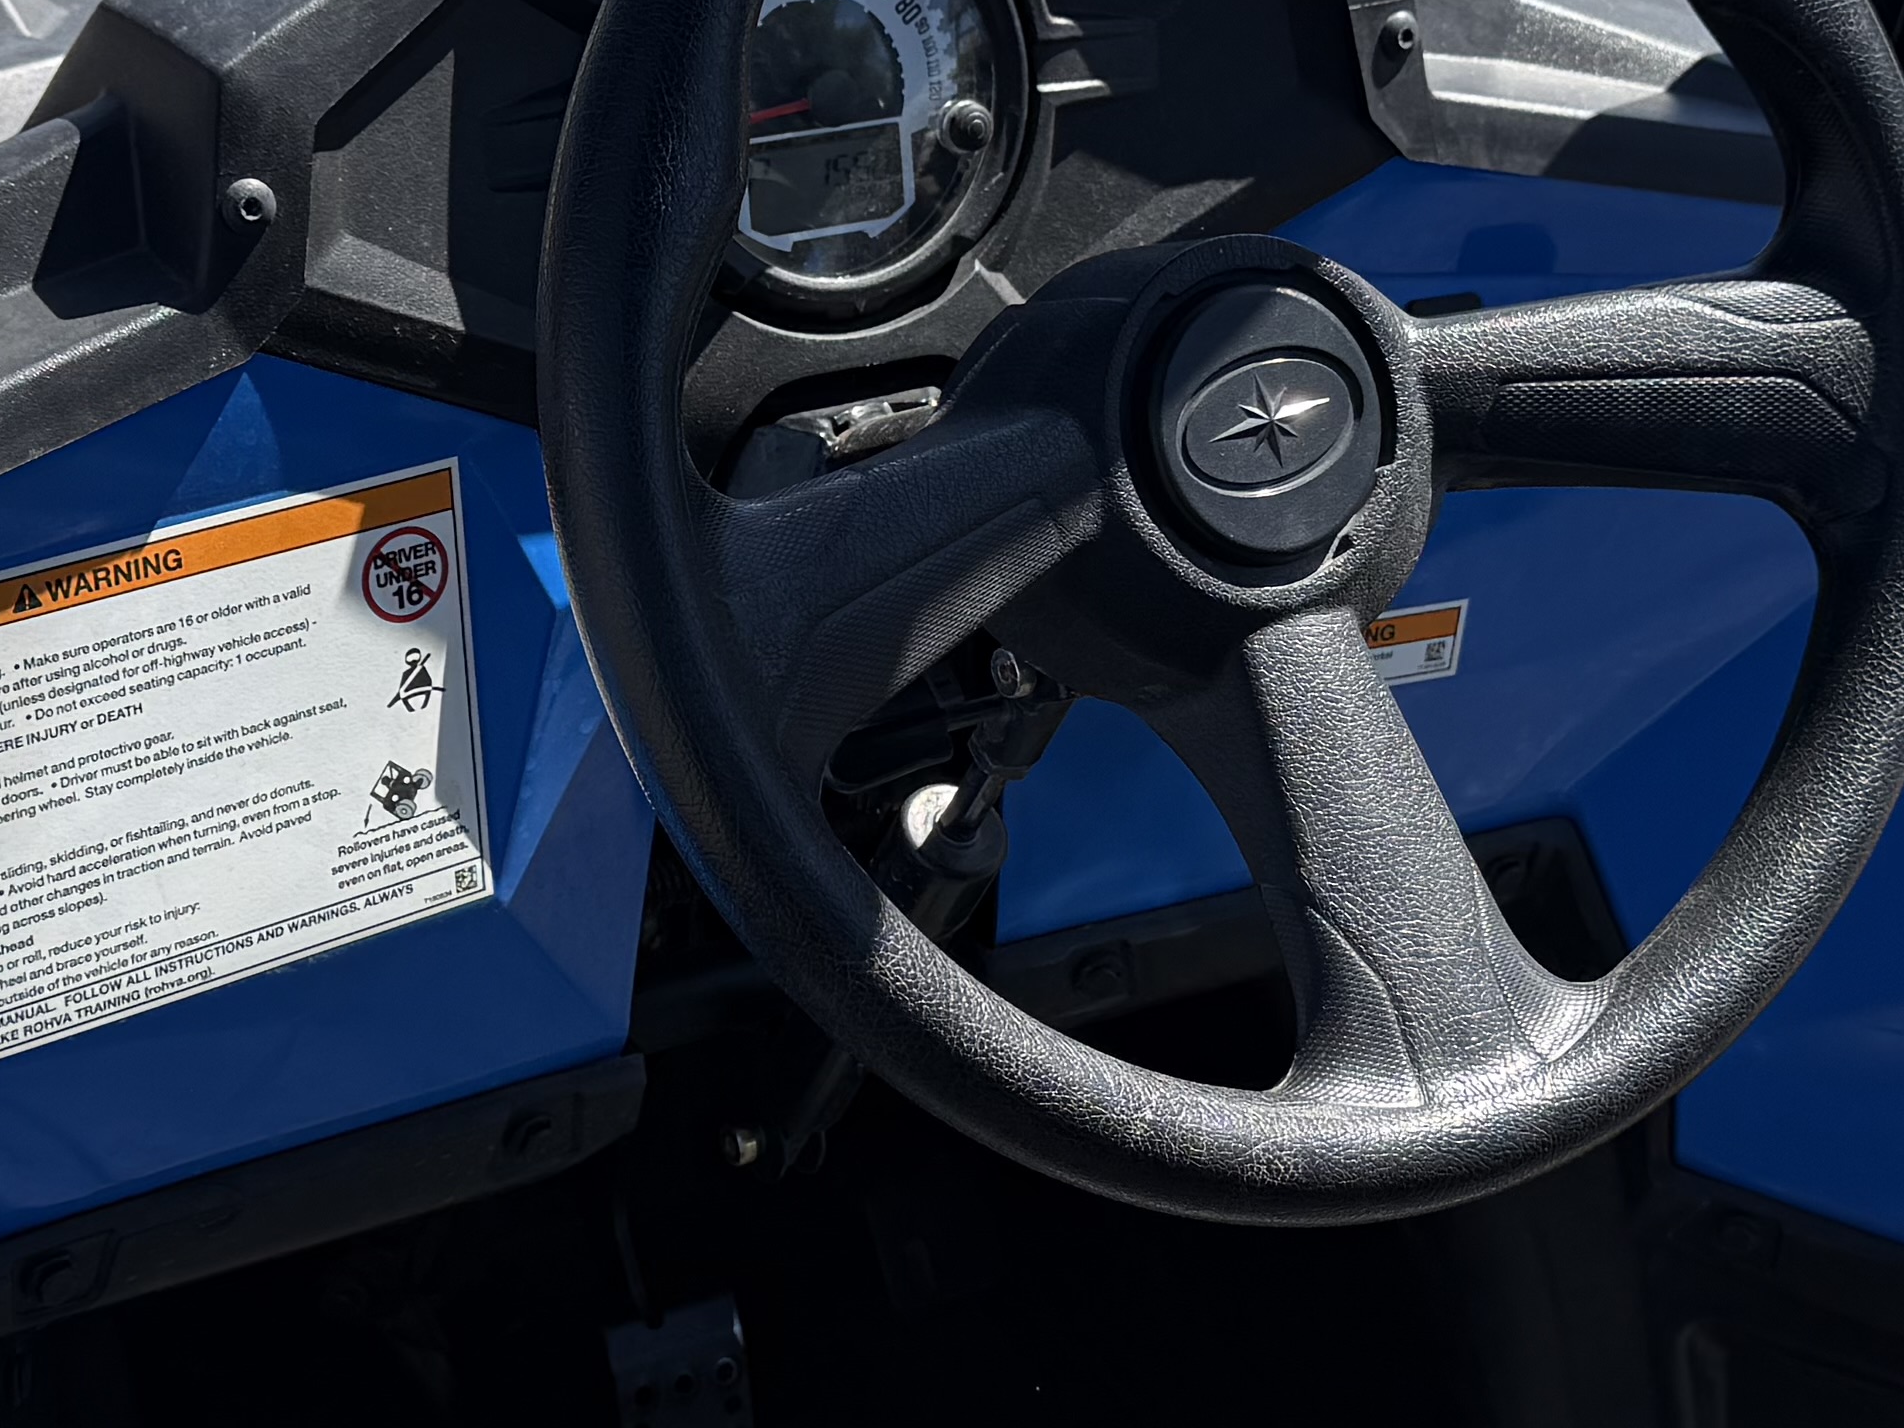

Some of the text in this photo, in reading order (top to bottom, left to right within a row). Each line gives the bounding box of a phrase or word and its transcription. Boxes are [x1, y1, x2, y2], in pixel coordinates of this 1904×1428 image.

[45, 548, 183, 603] WARNING
[374, 541, 436, 570] DRIVER
[376, 560, 437, 588] UNDER
[392, 580, 424, 609] 16
[22, 653, 59, 670] Make
[61, 644, 89, 660] sure
[91, 627, 154, 652] operators
[155, 621, 176, 634] are
[178, 614, 193, 627] 16
[195, 612, 208, 623] or
[210, 603, 243, 619] older
[244, 595, 270, 610] with
[272, 594, 280, 603] a
[281, 583, 311, 600] valid
[25, 719, 77, 745] INJURY
[80, 718, 94, 729] or
[96, 702, 143, 725] DEATH
[3, 764, 48, 787] helmet
[50, 756, 75, 774] and
[77, 740, 141, 768] protective
[143, 731, 174, 749] gear.
[37, 791, 80, 811] wheel.
[84, 782, 113, 798] Stay
[115, 761, 184, 789] completely
[185, 750, 223, 769] inside
[224, 744, 245, 757] the
[246, 731, 293, 751] vehicle.
[330, 856, 369, 875] severe
[369, 842, 411, 863] injuries
[412, 832, 433, 849] and
[337, 808, 461, 857] Rollovers have caused
[337, 873, 365, 889] even
[366, 868, 381, 880] on
[405, 851, 433, 867] open
[435, 839, 468, 858] areas.
[12, 908, 55, 929] across
[57, 891, 107, 915] slopes).
[46, 977, 59, 991] of
[61, 973, 82, 986] the
[83, 957, 128, 979] vehicle
[130, 951, 147, 964] for
[149, 943, 172, 958] any
[173, 930, 218, 950] reason.
[63, 977, 122, 1007] FOLLOW
[125, 969, 151, 987] ALL
[154, 935, 253, 977] INSTRUCTIONS
[256, 925, 284, 944] AND
[286, 901, 360, 933] WARNINGS.
[363, 883, 413, 908] ALWAYS
[22, 1012, 72, 1037] ROHVA
[73, 989, 140, 1019] TRAINING
